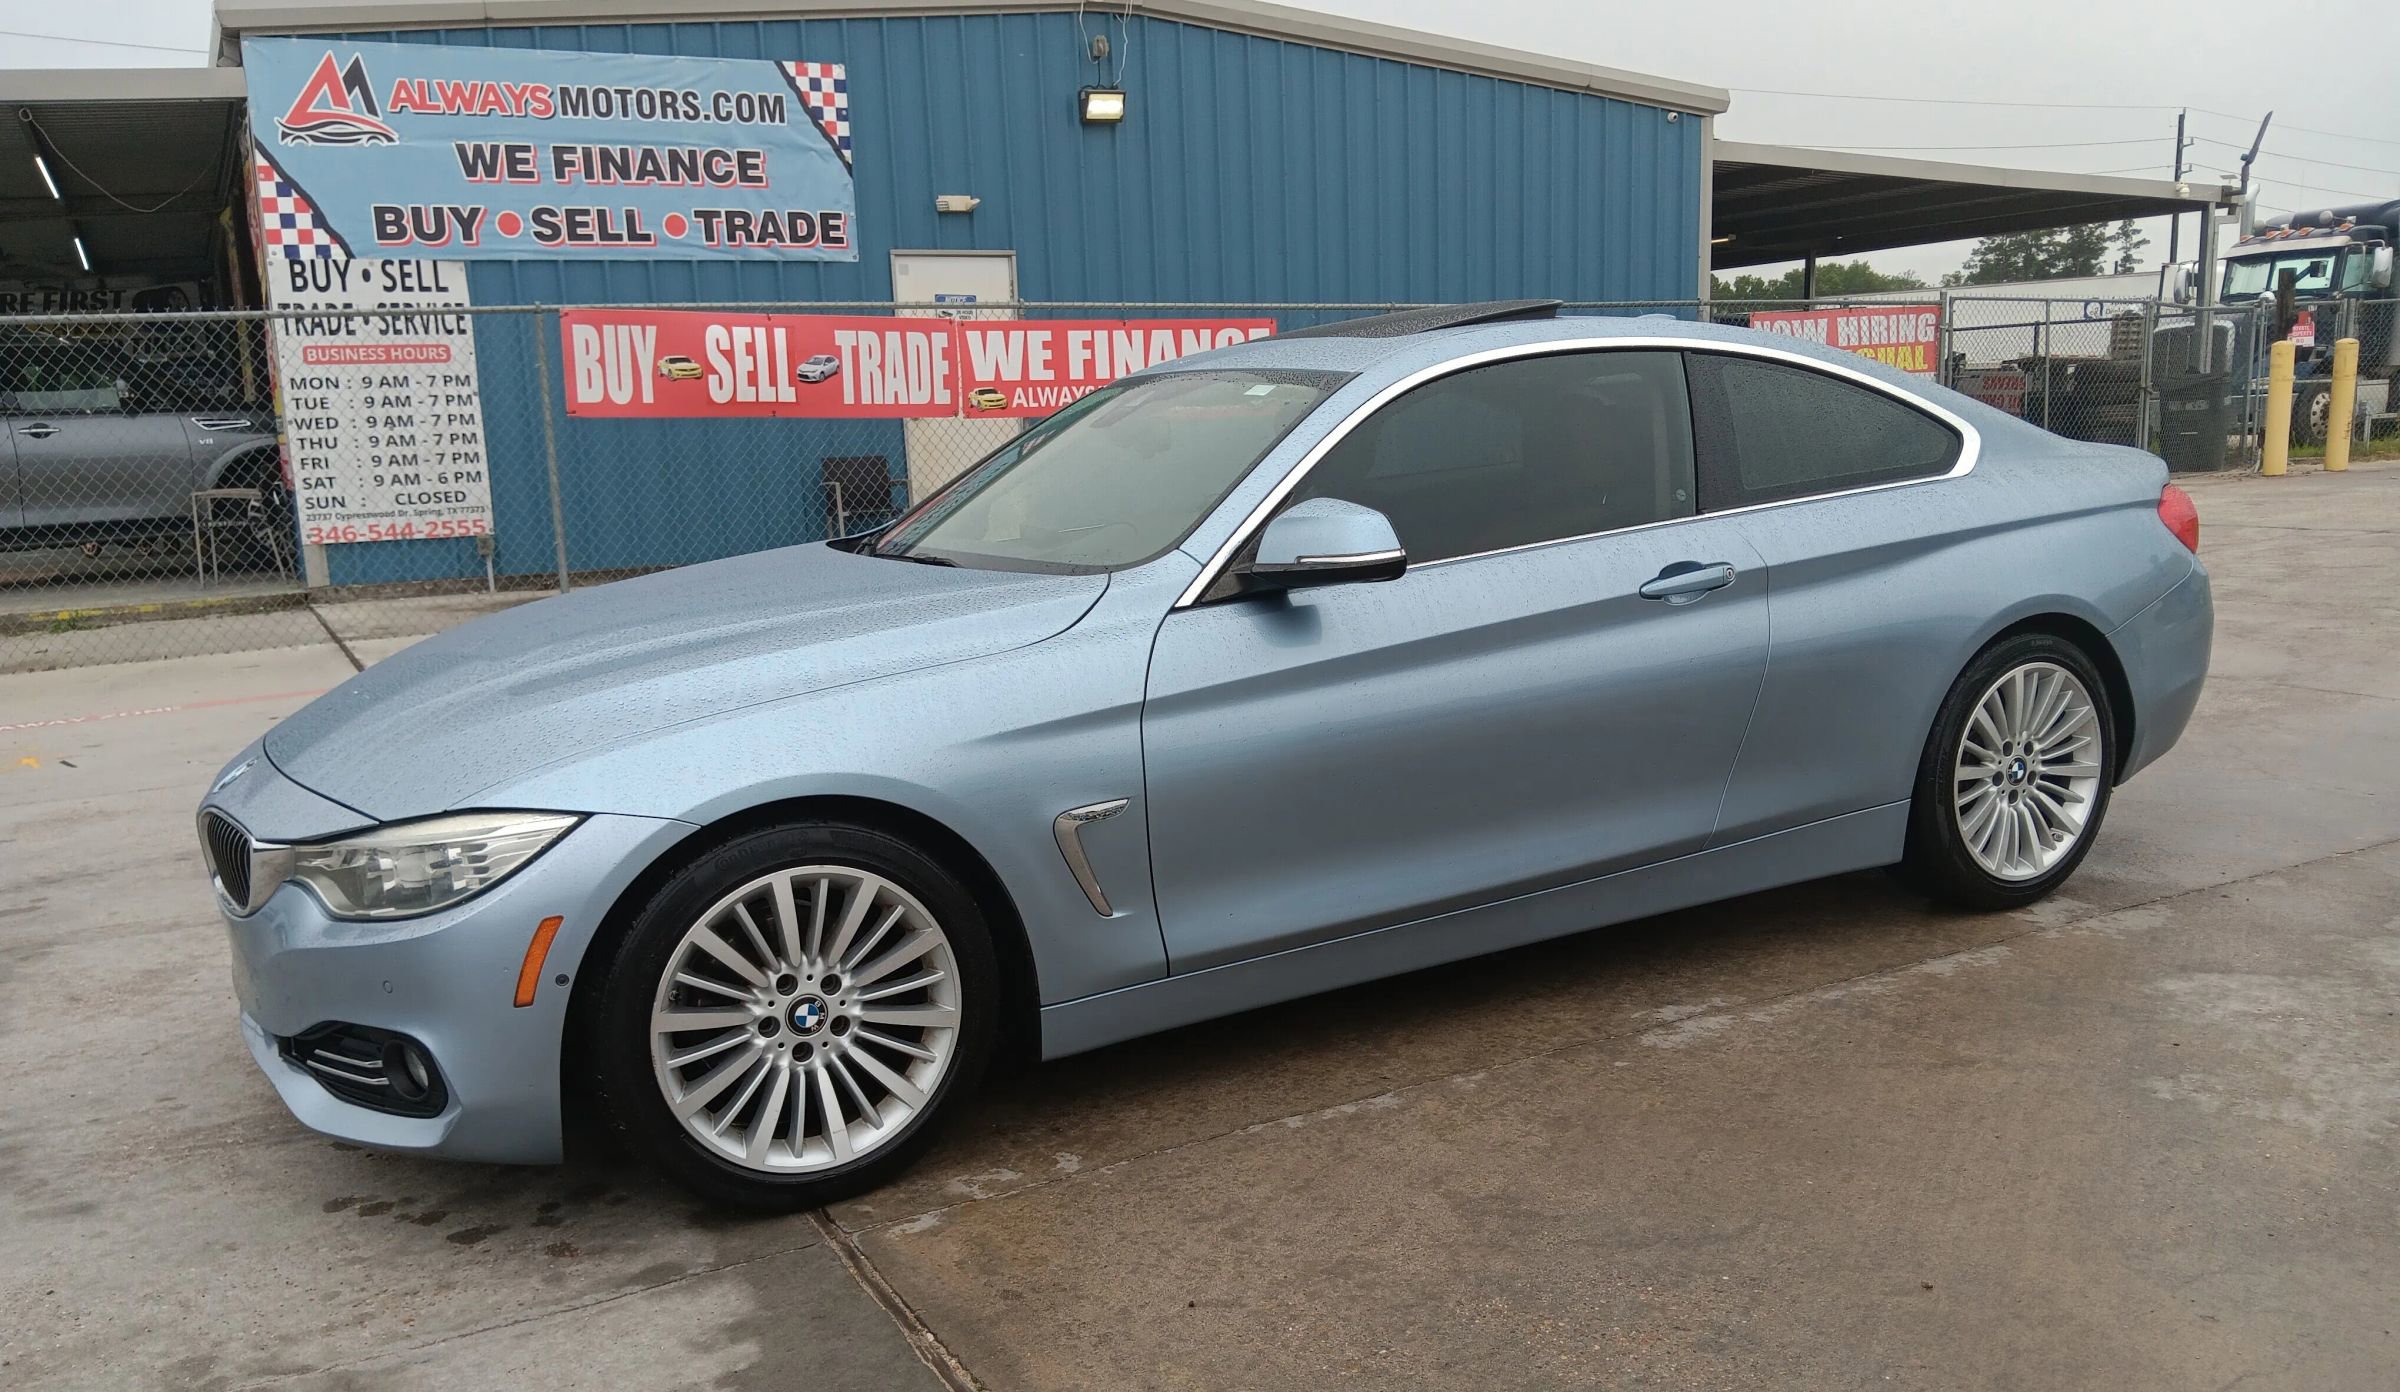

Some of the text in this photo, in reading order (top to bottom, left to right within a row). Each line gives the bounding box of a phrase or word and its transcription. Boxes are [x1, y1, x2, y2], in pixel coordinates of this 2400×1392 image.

[454, 141, 768, 188] WE FINANCE
[372, 204, 848, 249] BUY SELL TRADE
[290, 260, 449, 292] BUY SELL
[43, 289, 127, 311] FIRST
[277, 303, 467, 336] TRADE SERVICE
[1837, 313, 1936, 347] HIRING
[307, 347, 448, 362] BUSINESS HOURS
[572, 324, 951, 405] BUY SELL TRADE
[966, 328, 1270, 382] WE FINA
[290, 377, 339, 390] MON
[362, 377, 372, 388] 9
[379, 376, 409, 388] AM
[427, 376, 436, 387] 7
[444, 375, 470, 387] PM
[292, 398, 330, 410] TUE
[364, 396, 374, 408] 9
[381, 396, 411, 407] AM
[429, 395, 438, 407] 7
[446, 394, 472, 406] PM
[294, 417, 339, 430] WED
[367, 416, 377, 428] 9
[384, 415, 414, 428] AM
[431, 414, 441, 426] 7
[448, 414, 475, 426] PM
[297, 438, 338, 450] THU
[369, 436, 379, 448] 9
[386, 434, 416, 446] AM
[433, 434, 443, 446] 7
[450, 433, 478, 445] PM
[301, 458, 329, 470] FRI
[372, 456, 382, 467] 9
[388, 454, 418, 466] AM
[436, 453, 446, 465] 7
[453, 452, 480, 464] PM
[303, 477, 336, 490] SAT
[374, 475, 384, 487] 9
[391, 474, 420, 486] AM
[438, 473, 448, 484] 6
[455, 472, 482, 483] PM
[306, 496, 346, 509] SUN
[395, 491, 466, 505] CLOSED
[309, 519, 487, 544] 346-544-2555
